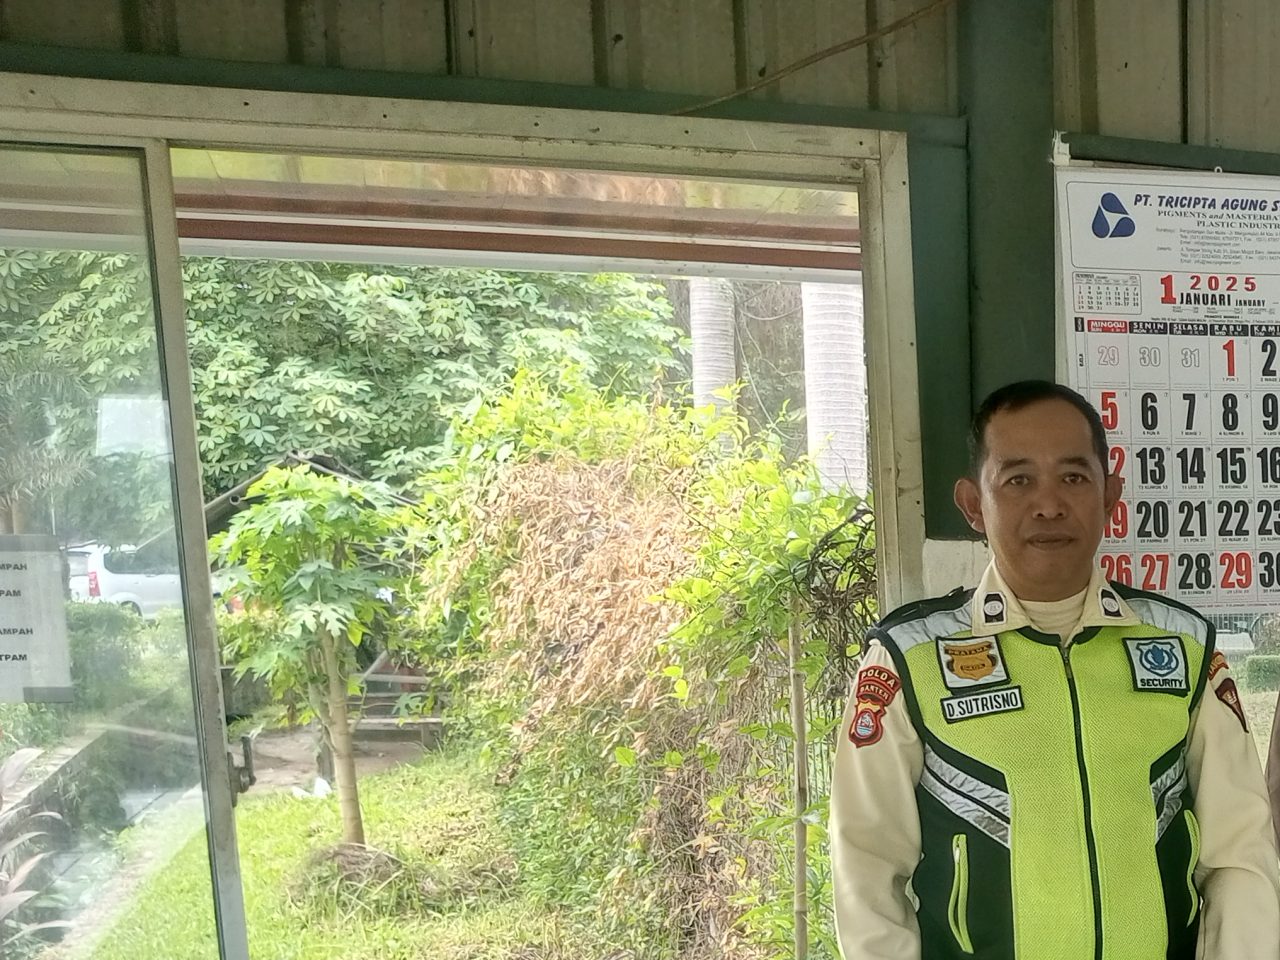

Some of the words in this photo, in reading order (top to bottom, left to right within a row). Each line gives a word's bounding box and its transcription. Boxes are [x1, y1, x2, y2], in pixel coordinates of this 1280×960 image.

[1133, 194, 1152, 207] PT.
[1157, 195, 1216, 209] TRICIPTA
[1220, 198, 1268, 211] AGUNG
[1157, 210, 1207, 219] PIGMENTS
[1196, 220, 1237, 229] PLASTIC
[1160, 274, 1177, 304] 1
[1190, 275, 1257, 292] 2025
[1179, 292, 1231, 306] JANUARI
[1235, 299, 1266, 307] JANUARY
[1133, 322, 1164, 330] SENIN
[1173, 323, 1205, 331] SELASA
[1214, 324, 1242, 332] RABU
[1097, 345, 1119, 366] 29
[1139, 346, 1161, 367] 30
[1181, 348, 1200, 368] 31
[1222, 339, 1236, 377] 1
[1261, 339, 1277, 377] 2
[1101, 391, 1118, 430] 5
[1141, 392, 1158, 430] 6
[1182, 393, 1196, 431] 7
[1222, 393, 1239, 431] 8
[1262, 393, 1279, 431] 9
[1135, 447, 1166, 485] 13
[1176, 447, 1206, 484] 14
[1216, 447, 1247, 485] 15
[1136, 500, 1170, 538] 20
[1178, 500, 1208, 537] 21
[1217, 500, 1250, 537] 22
[1101, 554, 1132, 588] 26
[1141, 553, 1170, 590] 27
[1177, 553, 1212, 590] 28
[1219, 552, 1252, 589] 29
[861, 669, 896, 688] POLDA
[1140, 678, 1184, 688] SECURITY
[860, 685, 889, 700] BANTEN
[946, 691, 1019, 718] D.SUTRISNO
